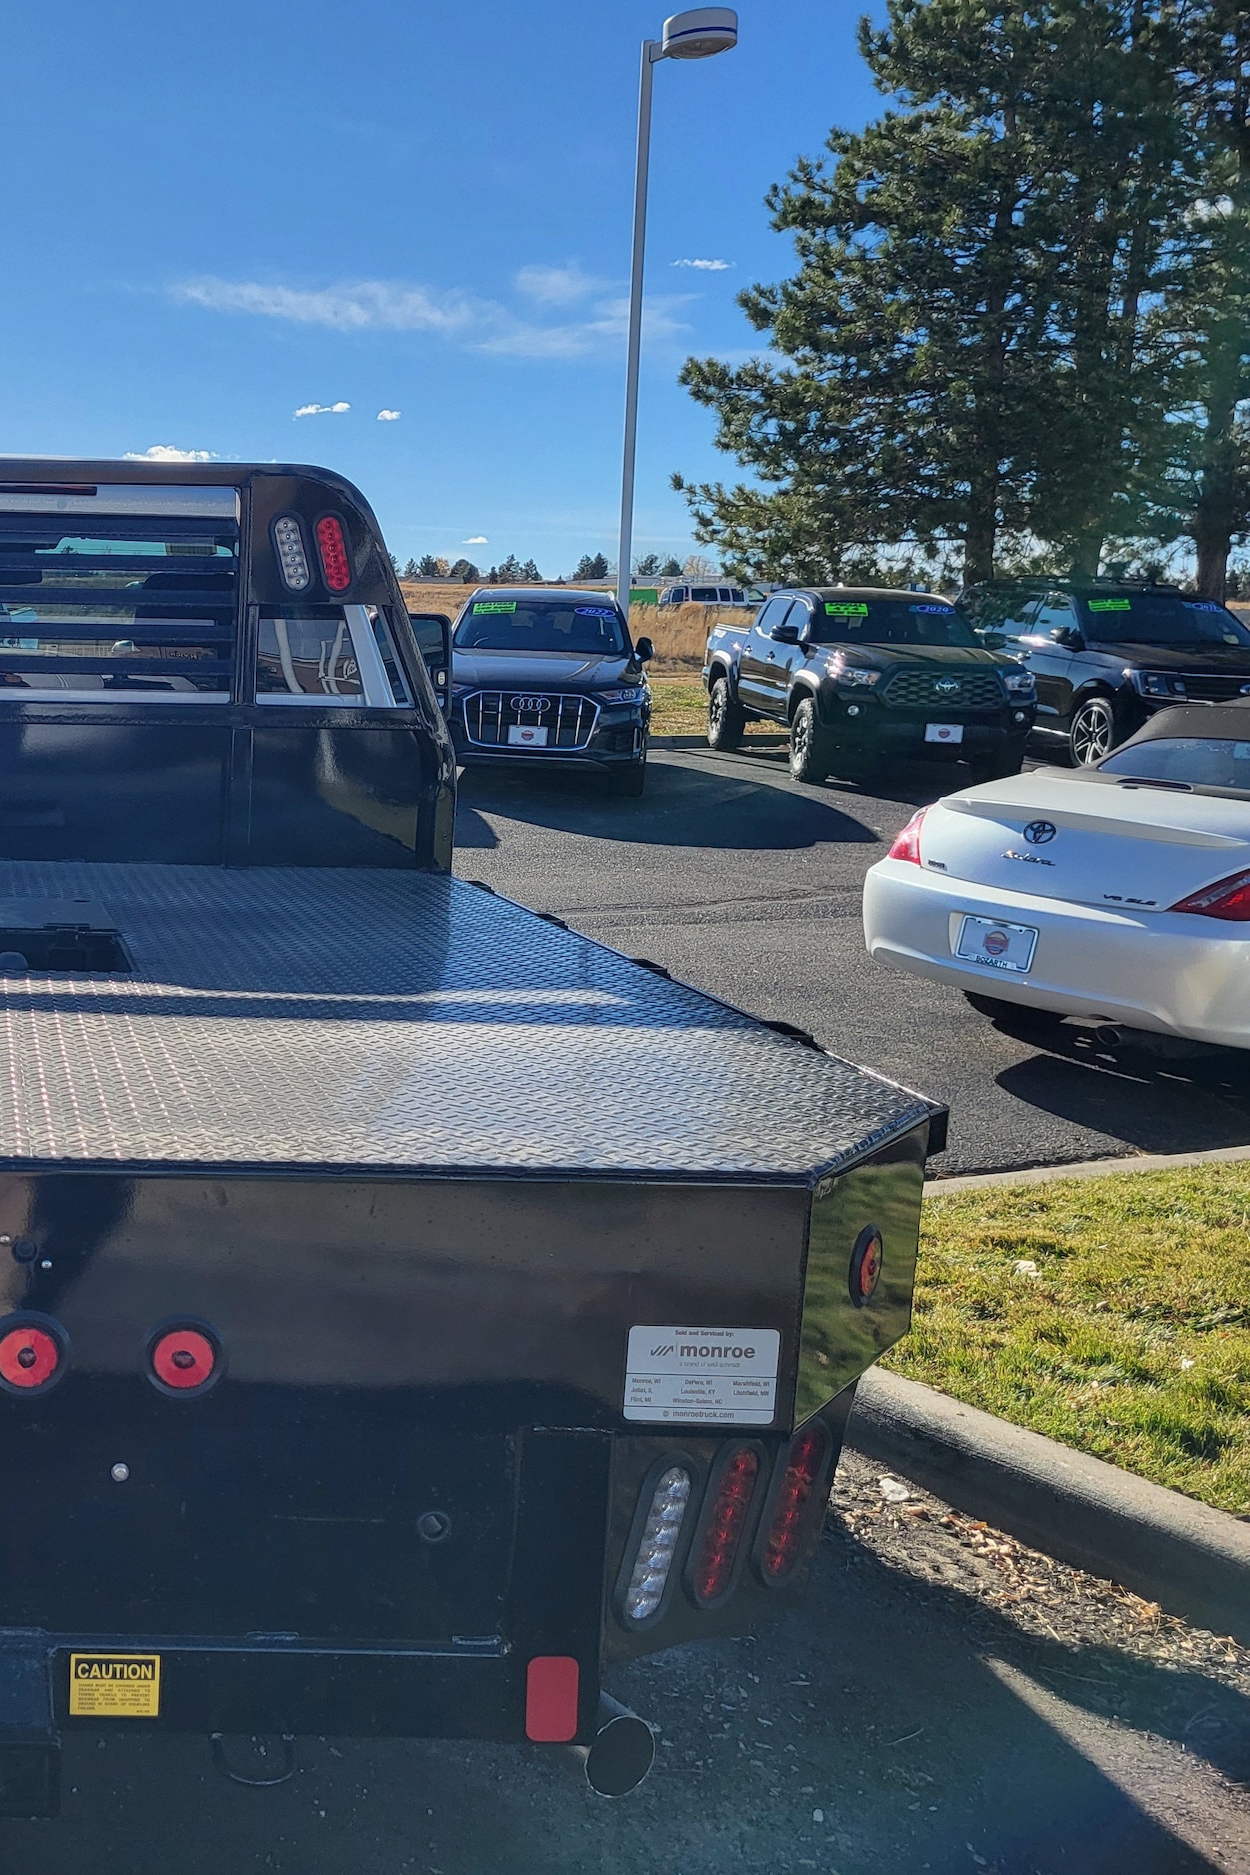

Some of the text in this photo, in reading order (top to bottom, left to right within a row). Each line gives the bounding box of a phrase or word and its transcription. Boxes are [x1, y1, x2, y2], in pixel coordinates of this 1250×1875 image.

[976, 955, 1008, 970] BOZARTH
[680, 1345, 756, 1358] monroe
[77, 1663, 152, 1679] CAUTION
